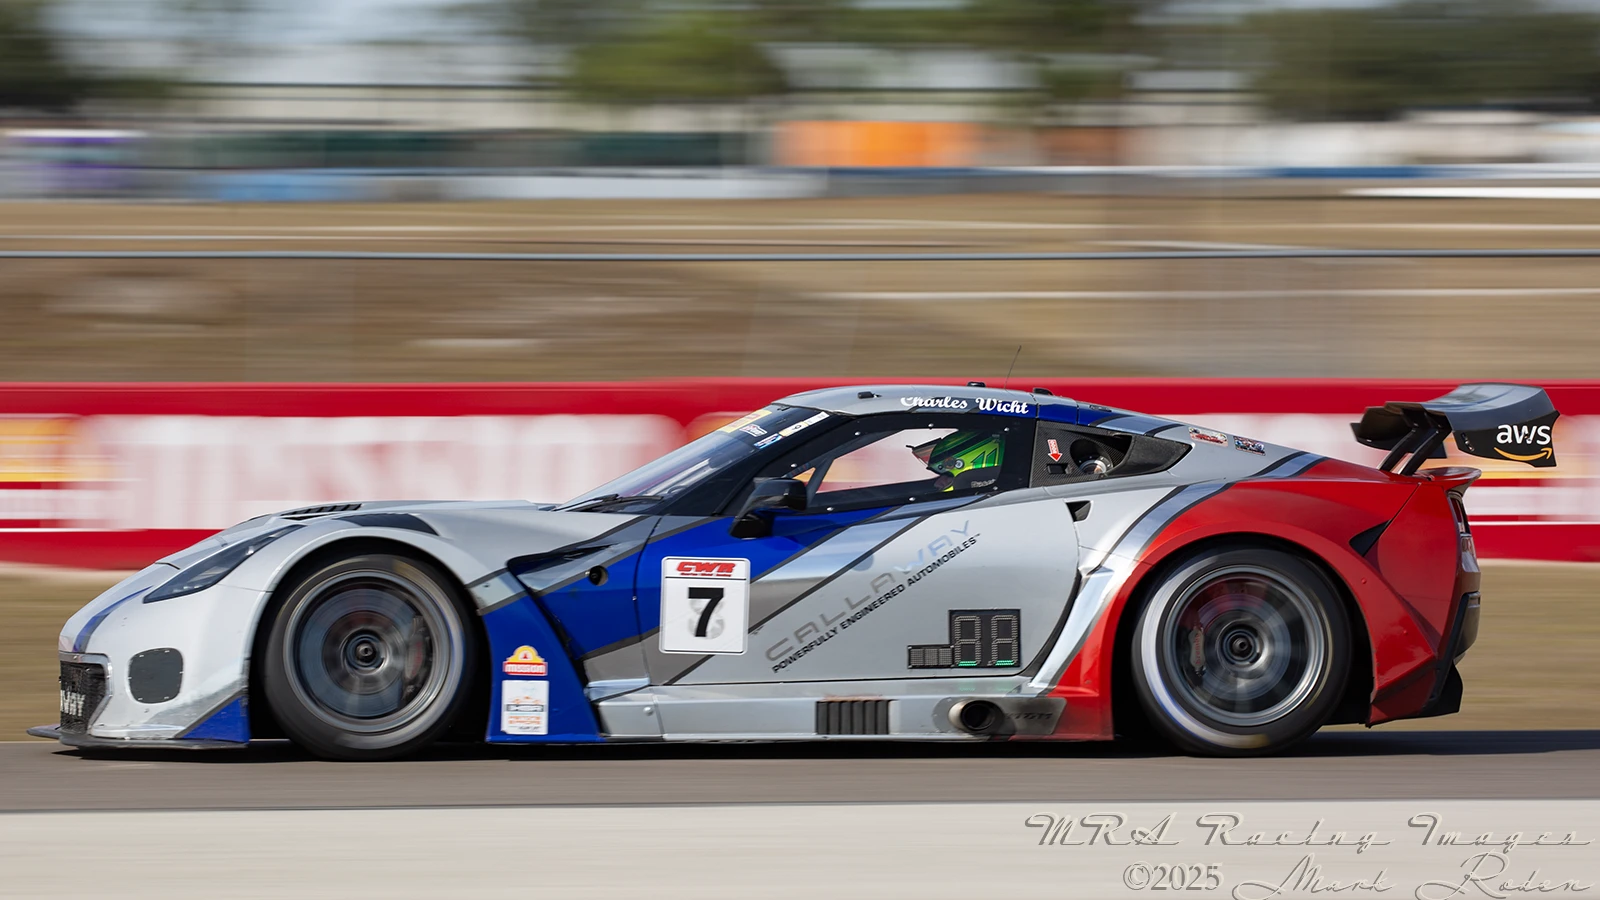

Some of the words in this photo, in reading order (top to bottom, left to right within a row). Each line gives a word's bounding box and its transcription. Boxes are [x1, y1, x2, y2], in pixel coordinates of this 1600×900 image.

[900, 396, 968, 409] Charles
[975, 397, 1029, 414] Wicht
[1496, 424, 1551, 445] aws
[688, 587, 724, 637] 7
[765, 520, 970, 662] CALLAWAY
[771, 628, 838, 674] POWERFULLY
[840, 583, 906, 630] ENGINEERED
